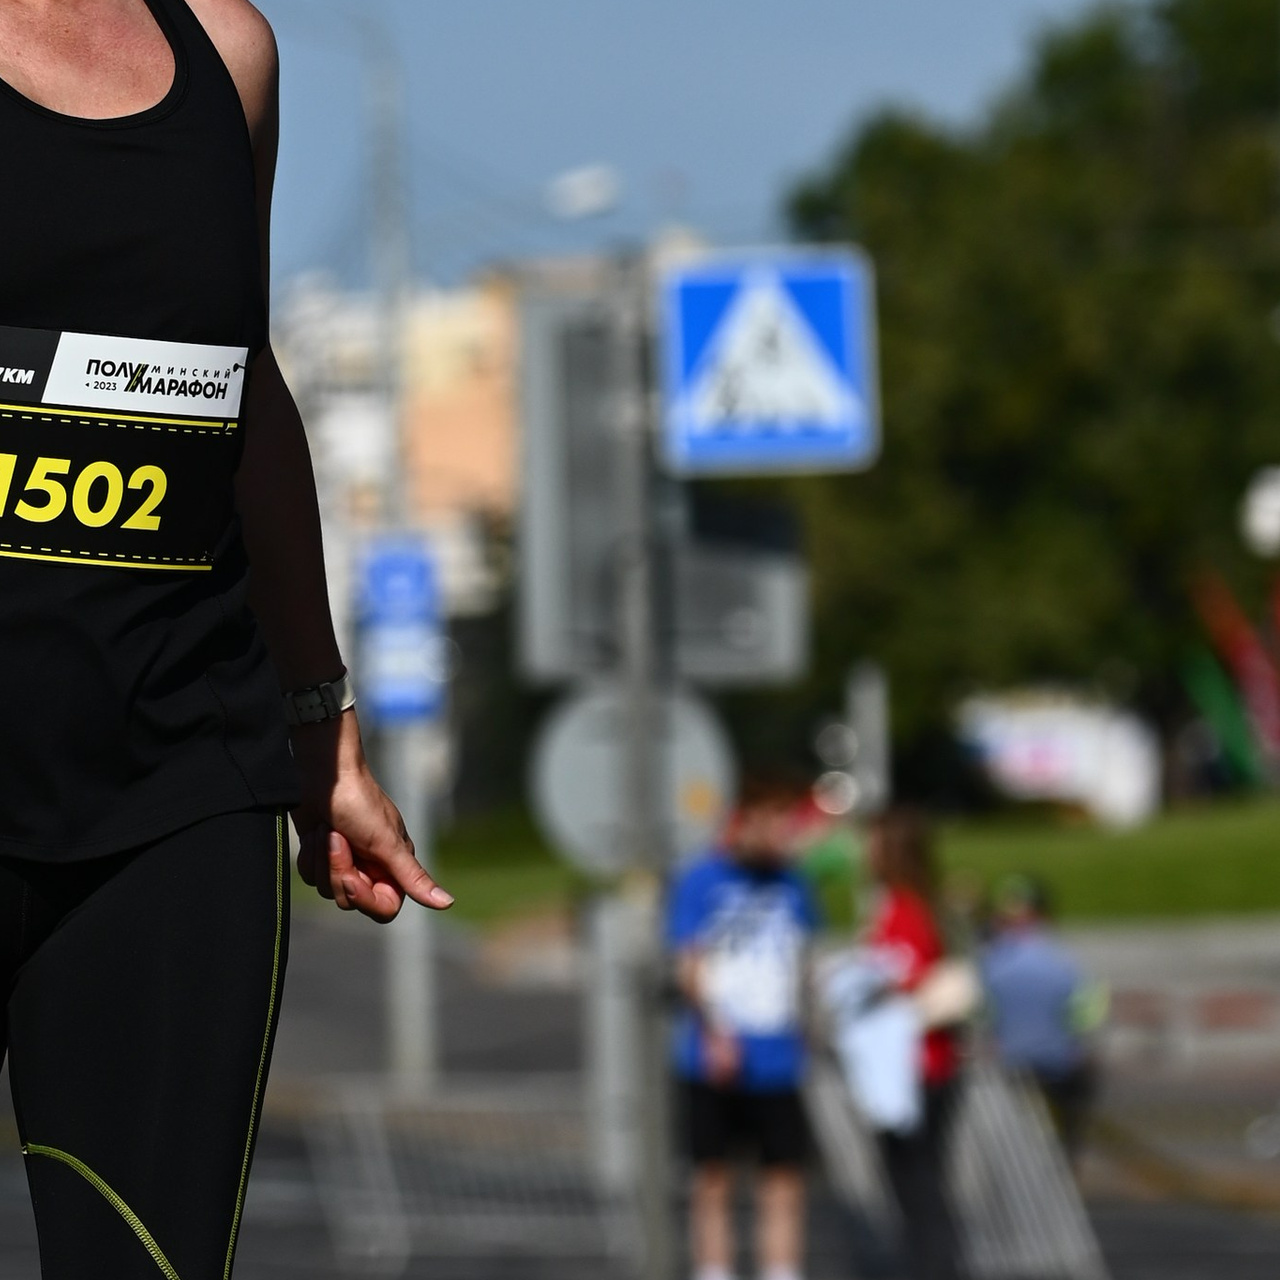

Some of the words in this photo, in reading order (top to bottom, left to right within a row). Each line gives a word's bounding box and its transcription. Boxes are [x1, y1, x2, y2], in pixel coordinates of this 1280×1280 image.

[151, 365, 231, 379] МИНСКИЙ
[93, 381, 117, 391] 2023
[128, 377, 228, 400] МАРАФОН
